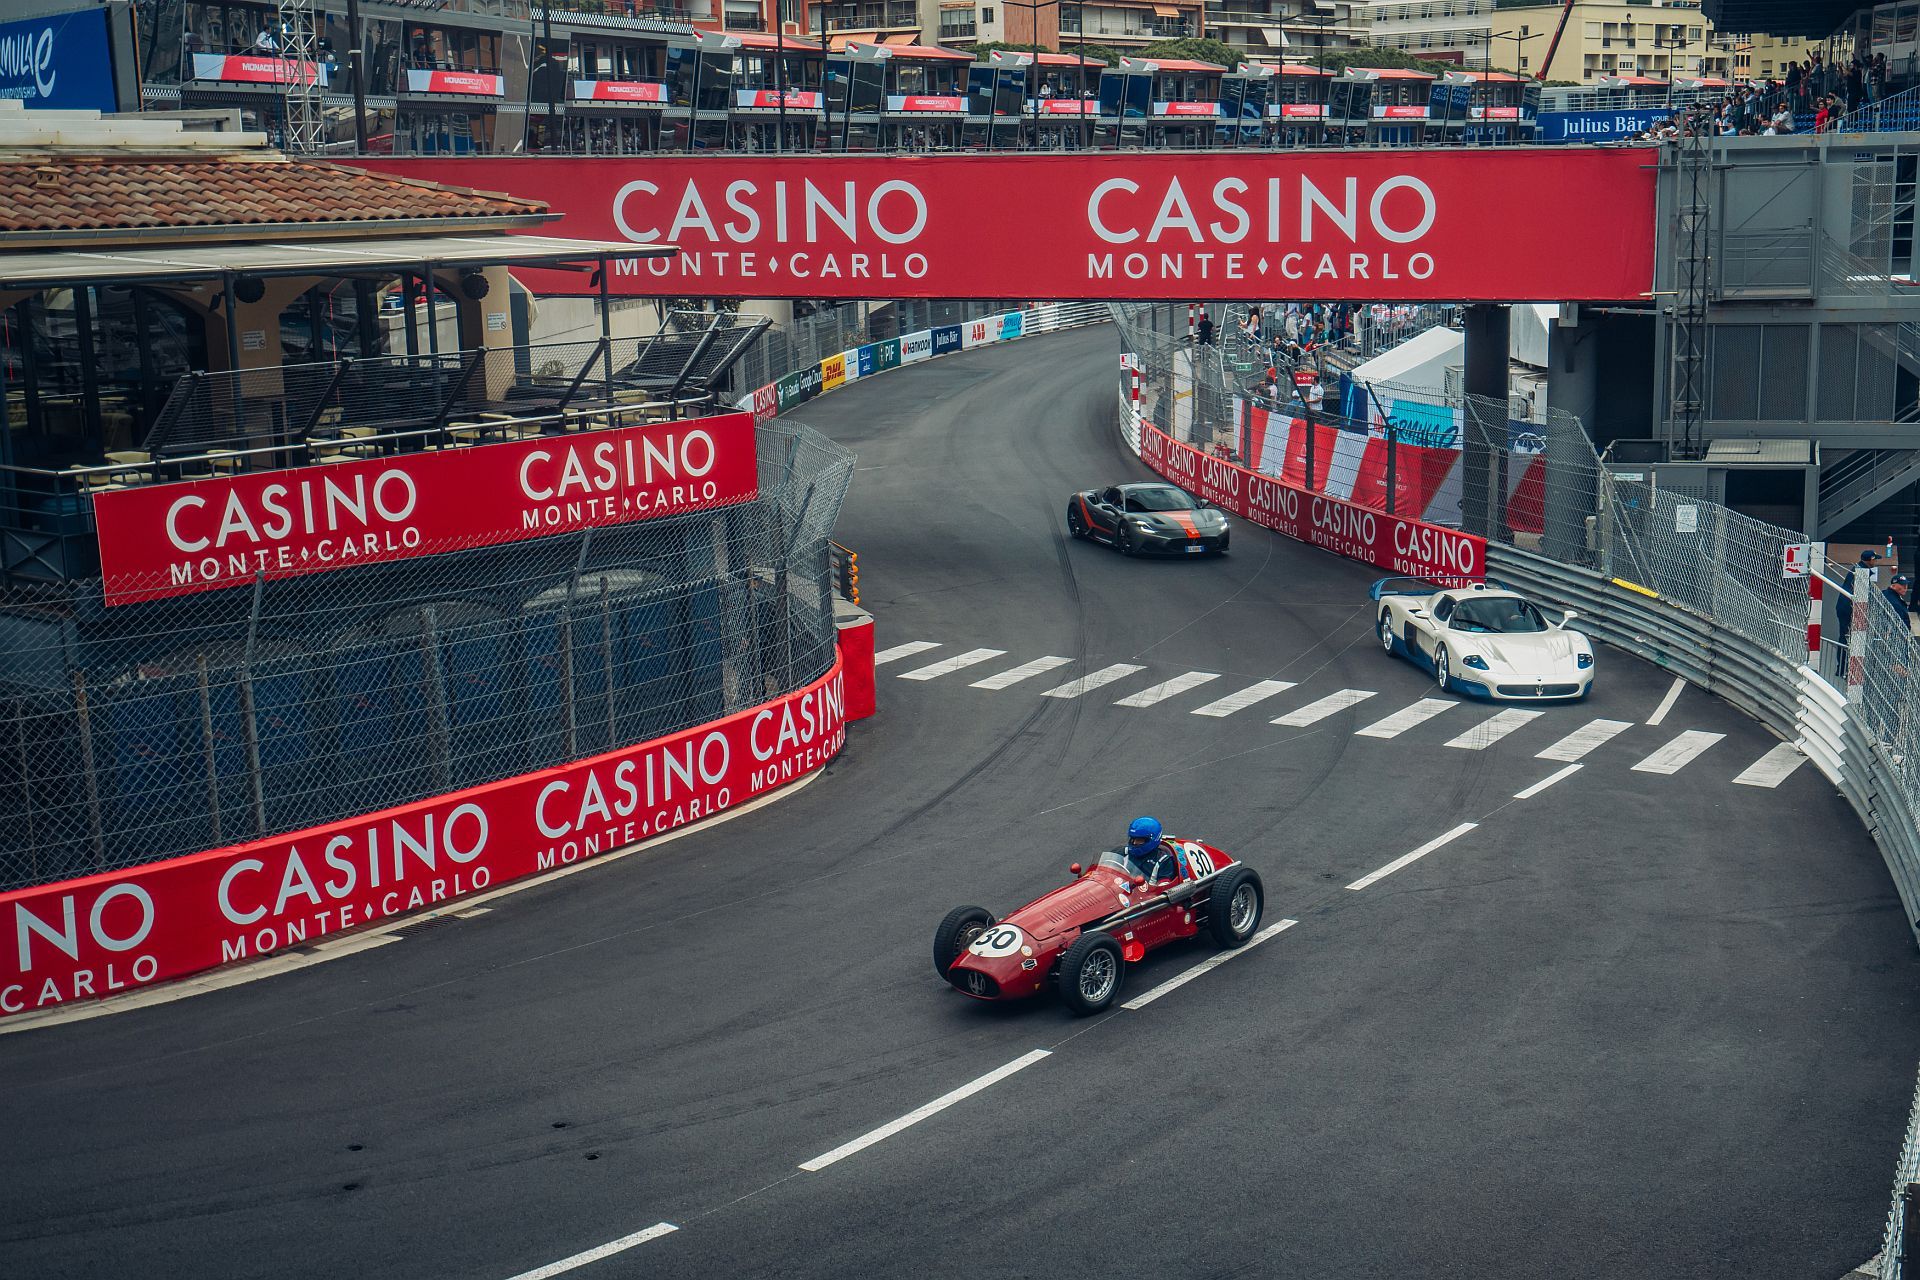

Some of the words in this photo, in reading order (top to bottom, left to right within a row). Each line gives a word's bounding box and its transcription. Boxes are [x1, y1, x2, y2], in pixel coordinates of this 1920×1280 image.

[1563, 117, 1609, 137] Julius
[1615, 116, 1646, 132] Bär
[613, 177, 927, 244] CASINO
[1087, 173, 1436, 244] CASINO
[615, 252, 756, 277] MONTE
[789, 253, 928, 278] CARLO
[1088, 253, 1244, 279] MONTE
[1281, 252, 1435, 280] CARLO
[885, 344, 895, 362] PIF
[972, 323, 986, 342] ABB
[755, 386, 776, 412] CASINO
[1142, 422, 1163, 459] CASINO
[1166, 439, 1195, 478] CASINO
[519, 429, 715, 501] CASINO
[1201, 456, 1239, 497] CASINO
[166, 469, 417, 553] CASINO
[522, 496, 616, 530] MONTE
[636, 480, 717, 511] CARLO
[1201, 484, 1218, 503] MONTE
[1221, 494, 1239, 512] CARLO
[1248, 476, 1298, 520] CASINO
[1248, 506, 1270, 526] MONTE
[1274, 517, 1298, 537] CARLO
[1311, 497, 1376, 545] CASINO
[170, 545, 292, 586] MONTE
[317, 526, 421, 562] CARLO
[1311, 529, 1339, 551] MONTE
[1345, 542, 1376, 564] CARLO
[1394, 521, 1475, 574] CASINO
[1393, 557, 1430, 581] MONTE
[750, 670, 844, 762] CASINO
[535, 731, 730, 839] CASINO
[751, 748, 814, 792] MONTE
[537, 821, 635, 871] MONTE
[655, 787, 730, 832] CARLO
[217, 803, 489, 925] CASINO
[1189, 849, 1212, 878] 30
[15, 883, 155, 973] NO
[222, 904, 355, 962] MONTE
[382, 866, 491, 916] CARLO
[975, 927, 1017, 949] 30
[0, 955, 158, 1012] CARLO
